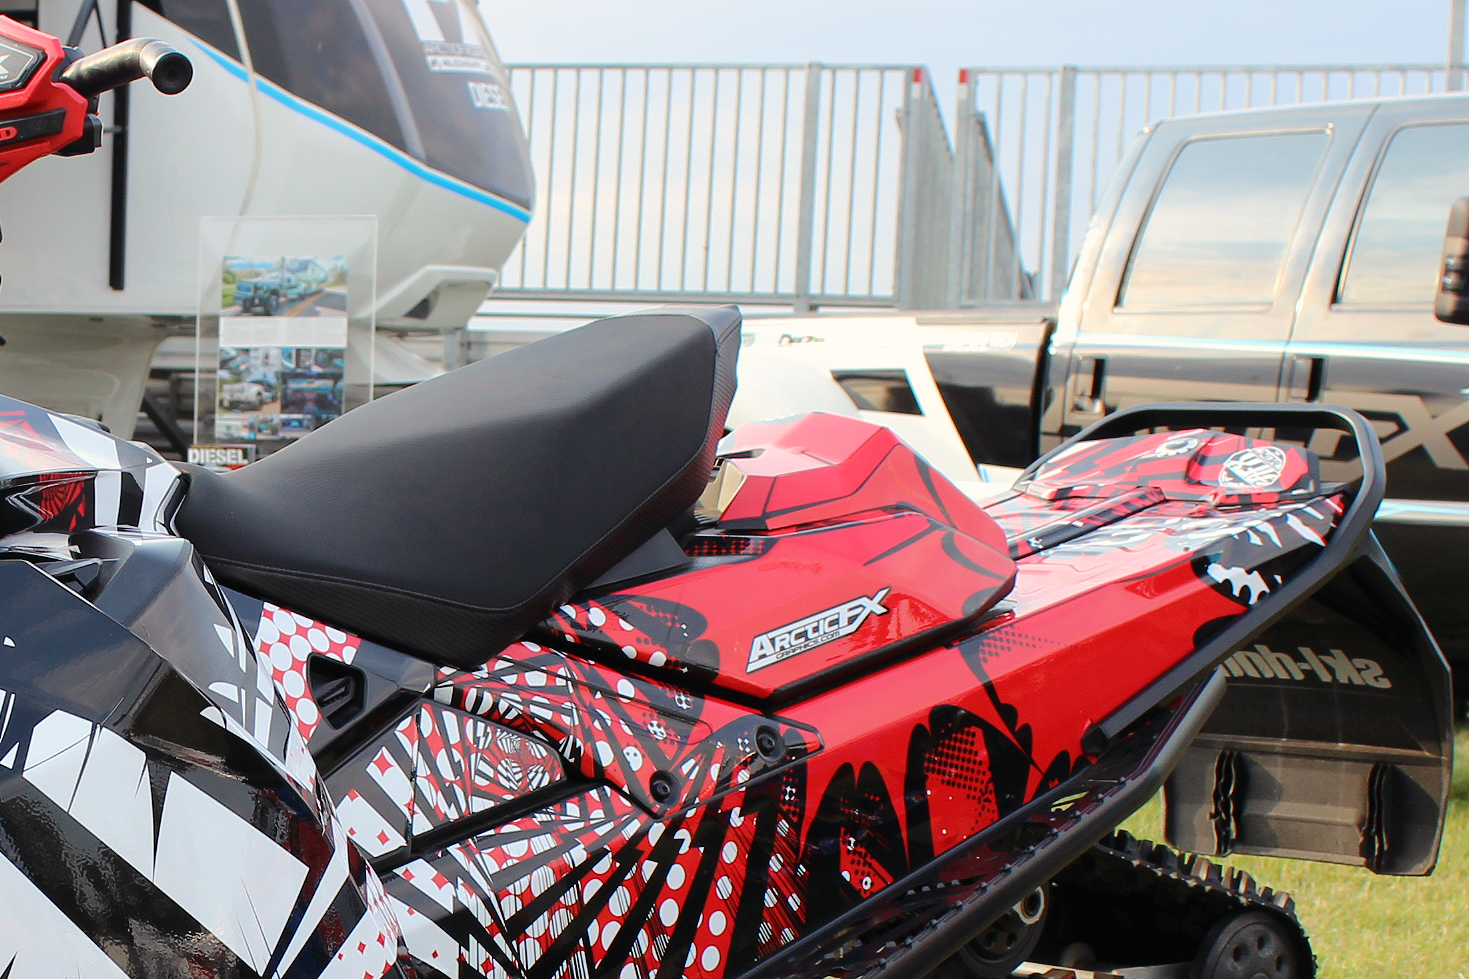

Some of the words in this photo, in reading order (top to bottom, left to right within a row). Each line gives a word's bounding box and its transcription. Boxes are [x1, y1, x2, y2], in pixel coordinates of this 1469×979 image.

[188, 447, 249, 465] DIESEL
[749, 586, 892, 663] ARCTICFX
[775, 631, 841, 660] GRAPHICS.COM
